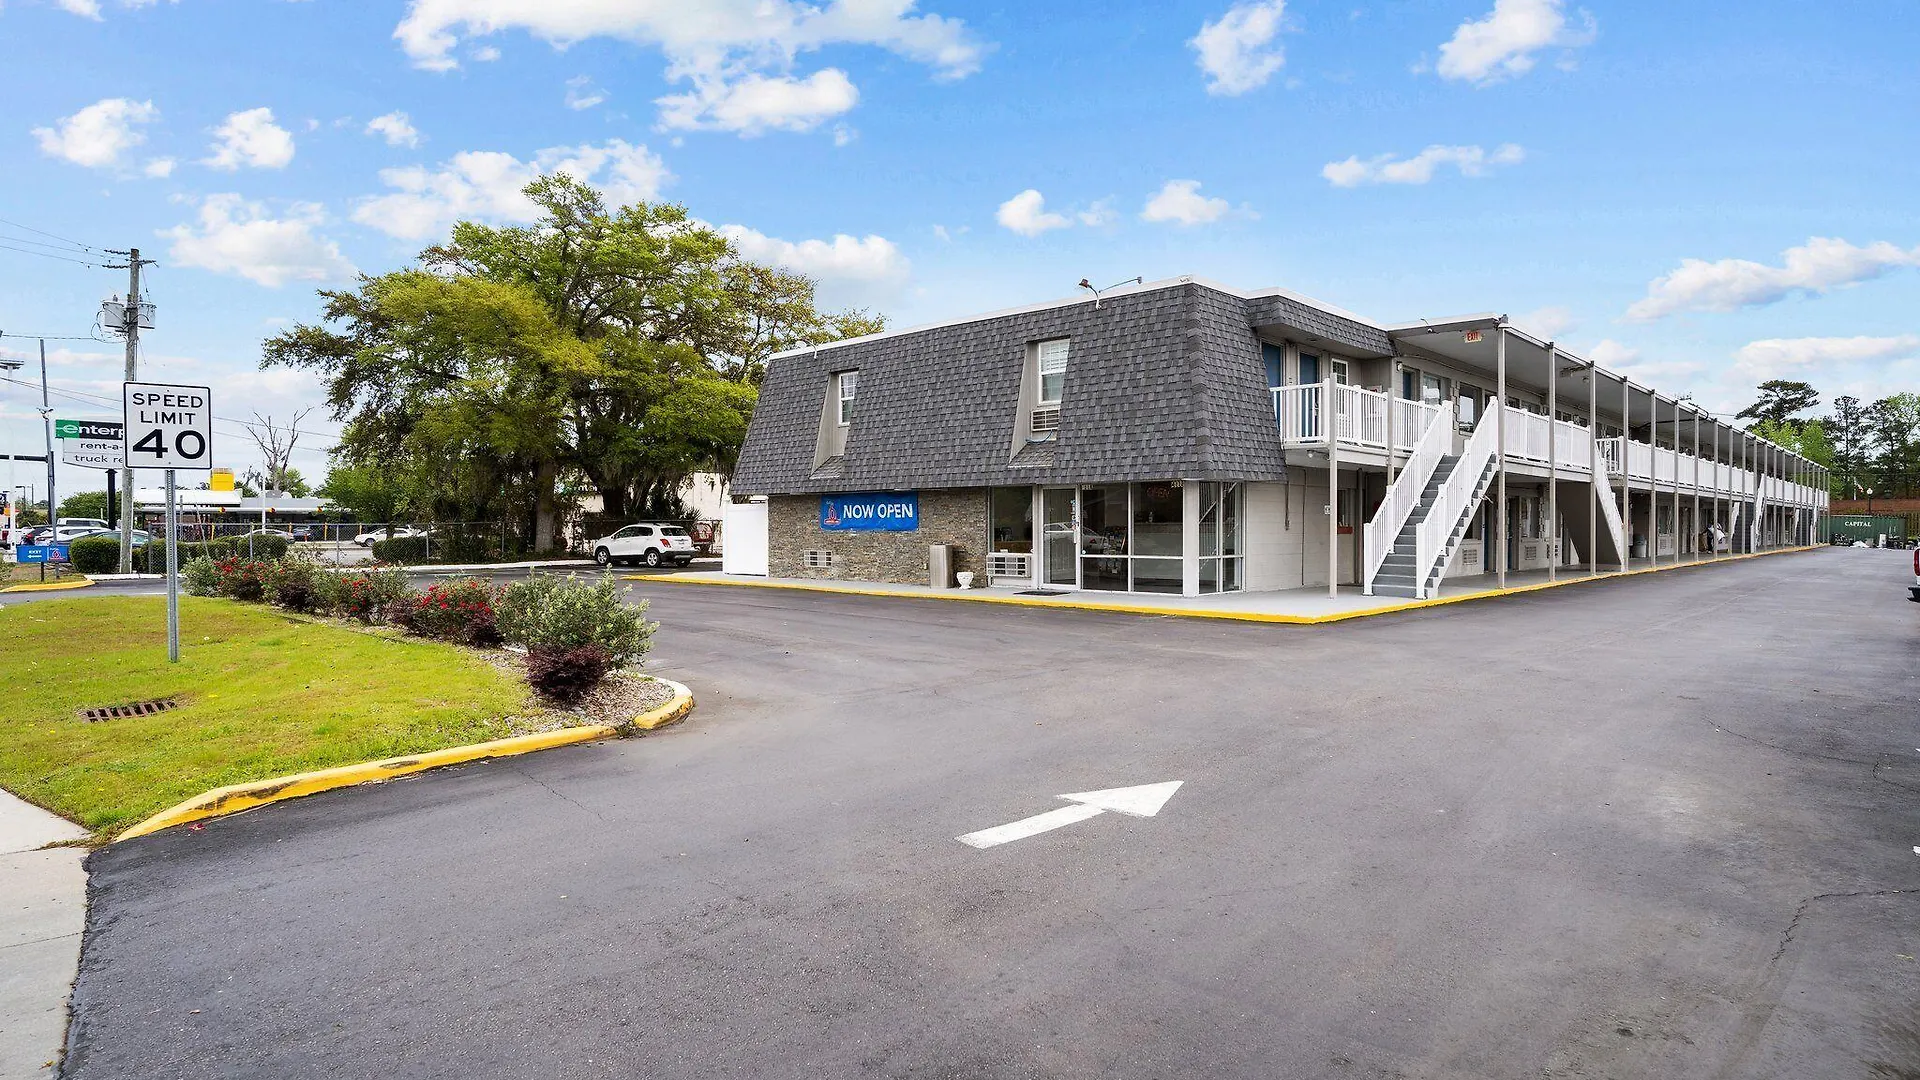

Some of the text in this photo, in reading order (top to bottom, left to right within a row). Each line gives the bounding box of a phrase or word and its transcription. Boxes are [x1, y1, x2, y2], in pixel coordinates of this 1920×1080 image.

[1467, 331, 1480, 341] EXIT
[133, 393, 203, 408] SPEED
[141, 411, 196, 425] LIMIT
[133, 429, 206, 460] 40
[75, 454, 108, 463] truck
[843, 503, 913, 519] NOW OPEN
